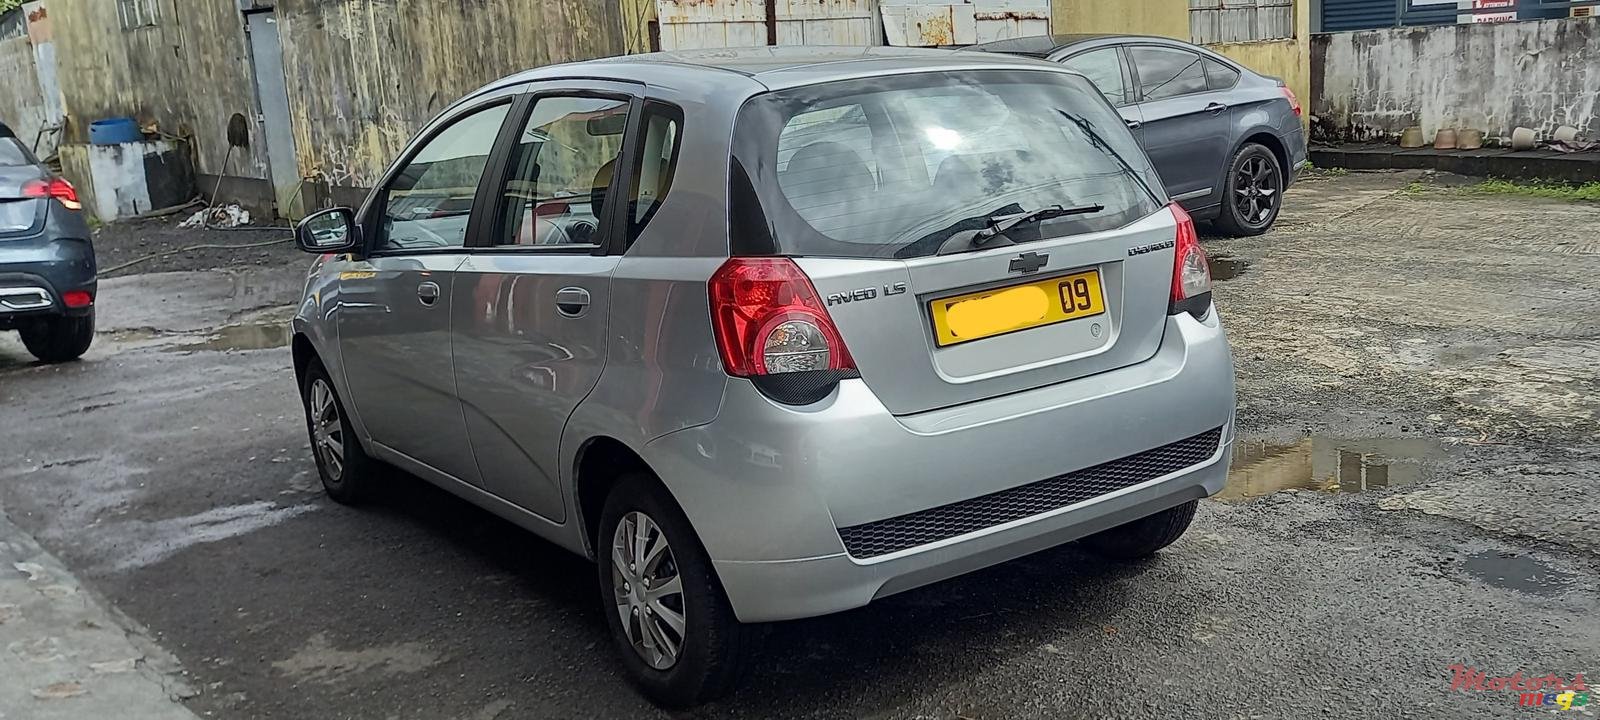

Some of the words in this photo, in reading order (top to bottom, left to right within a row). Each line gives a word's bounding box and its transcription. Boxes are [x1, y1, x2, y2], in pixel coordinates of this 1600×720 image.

[826, 287, 877, 306] AVEO
[883, 282, 906, 296] LS
[1058, 278, 1092, 314] 09
